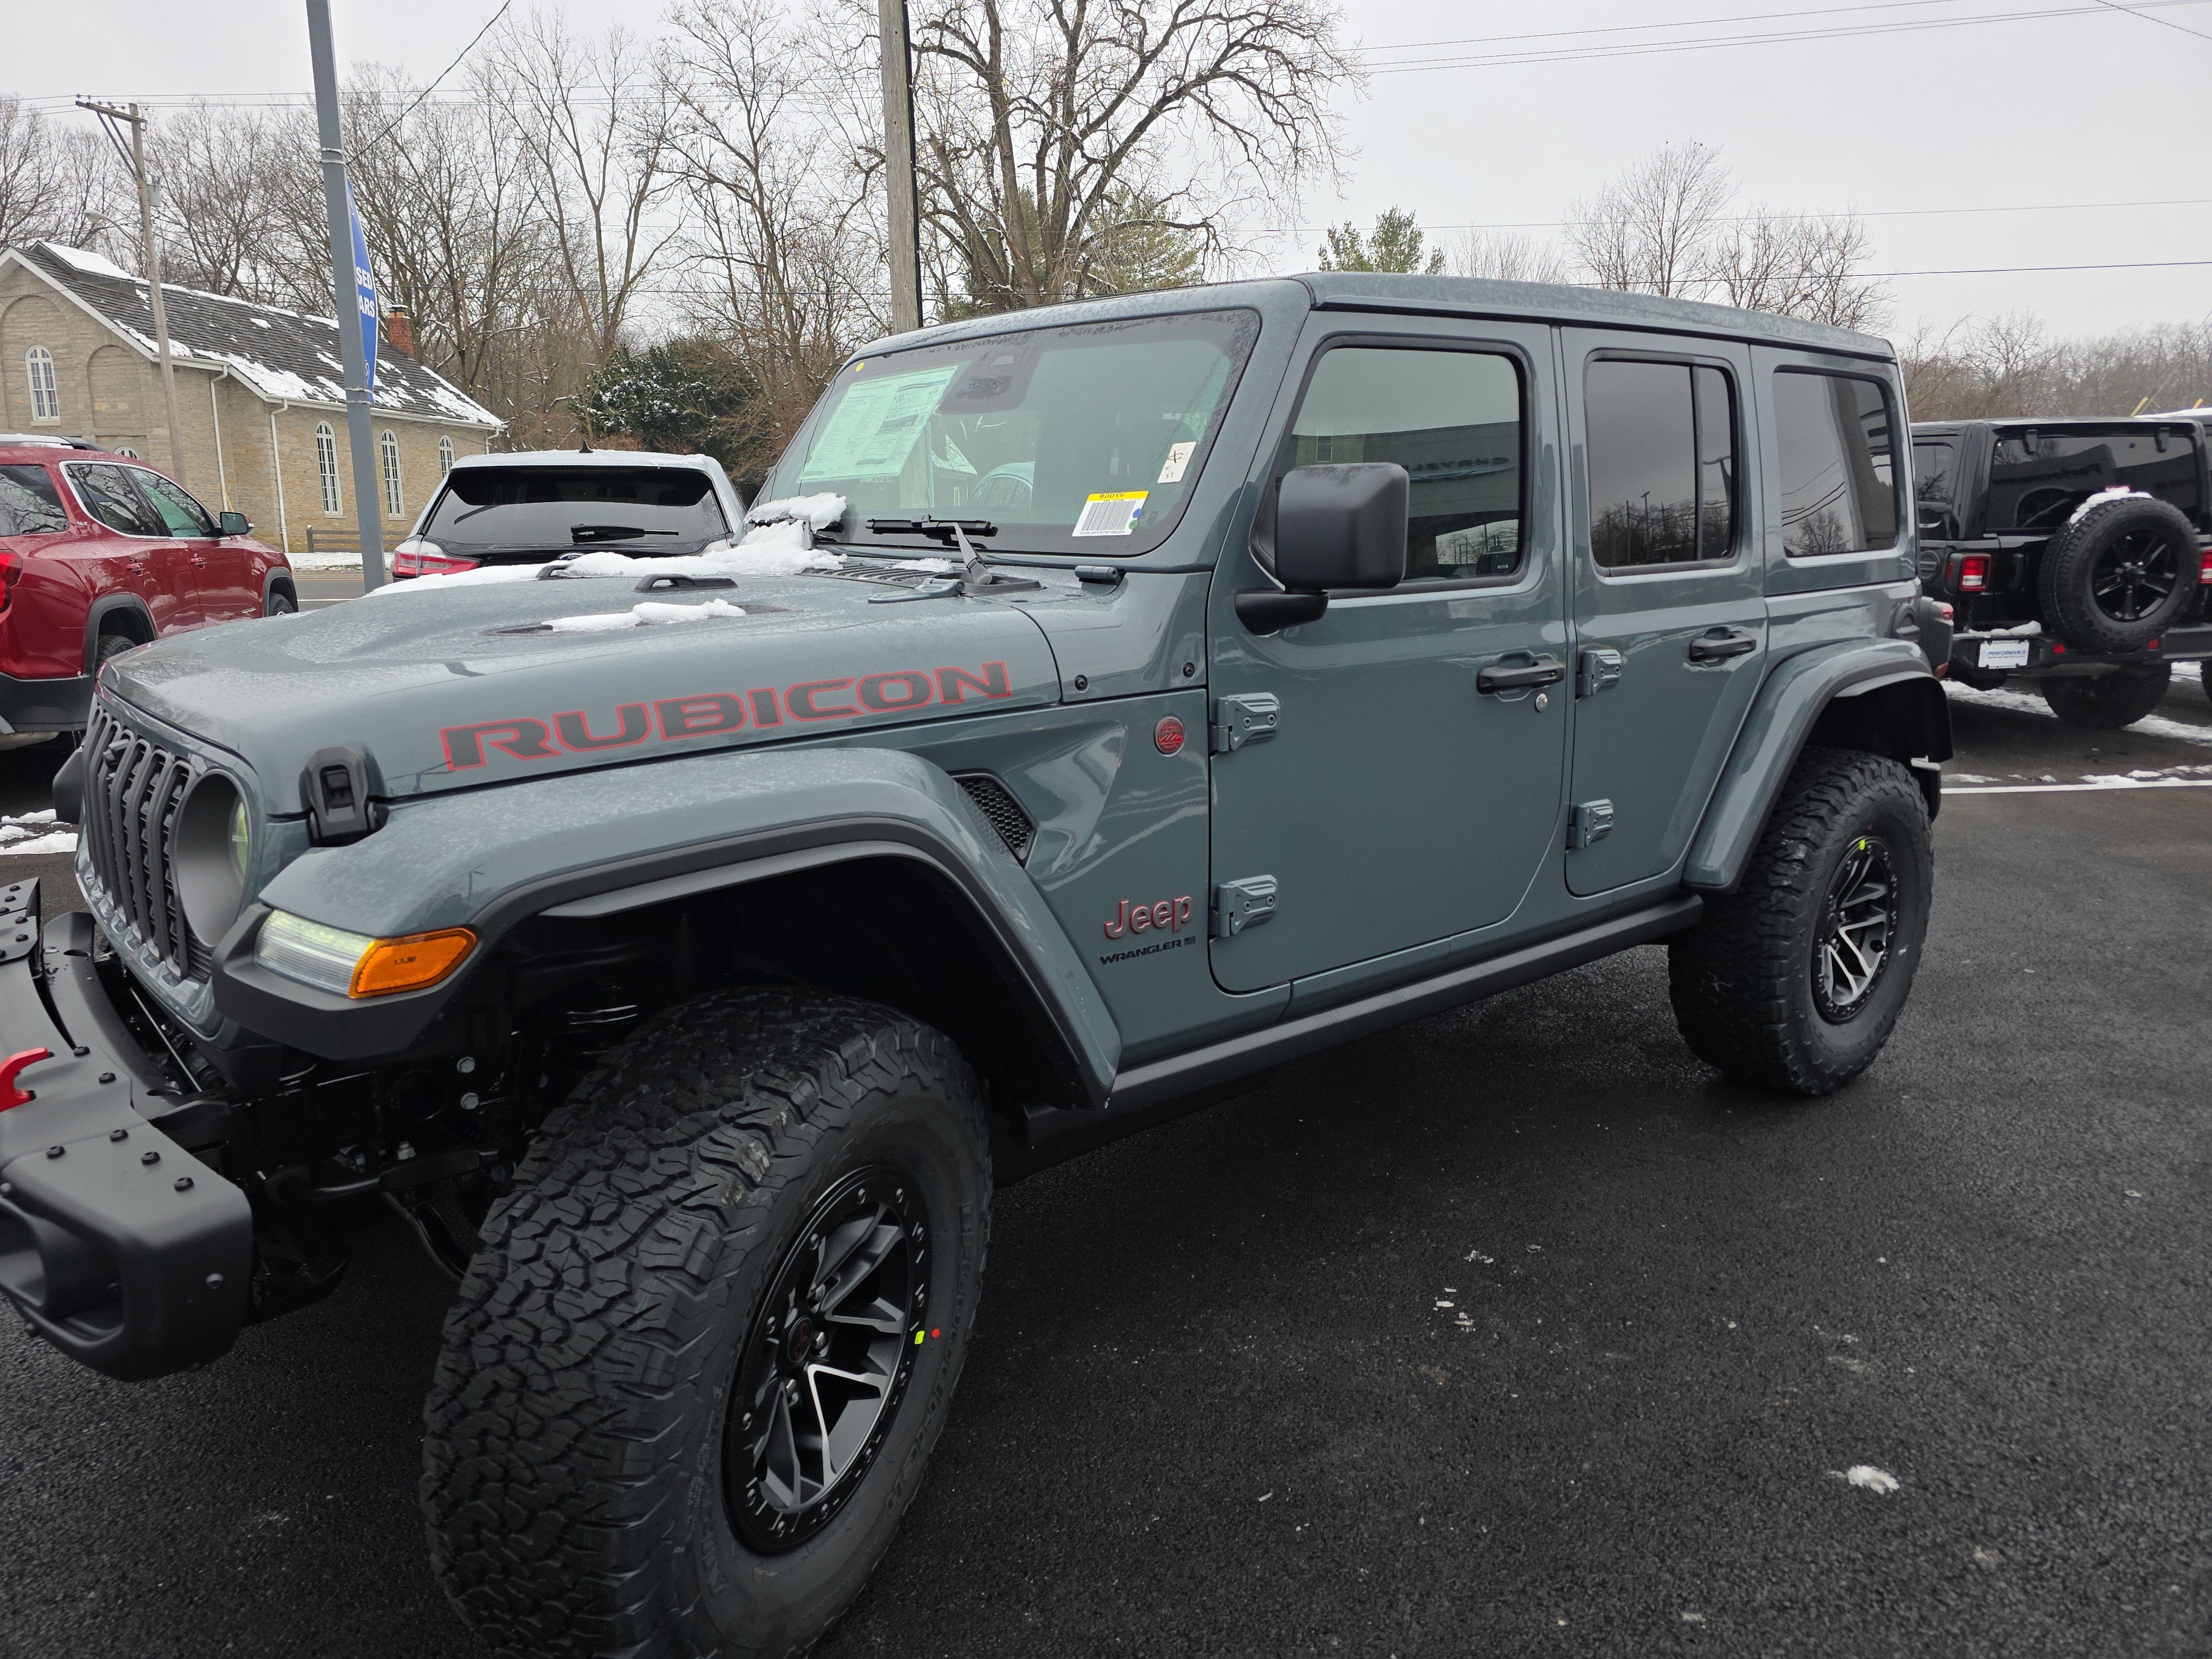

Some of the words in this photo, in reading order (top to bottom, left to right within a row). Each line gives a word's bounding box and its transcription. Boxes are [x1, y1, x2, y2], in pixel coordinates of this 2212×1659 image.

[356, 266, 372, 290] SED
[358, 295, 375, 318] ARS
[440, 661, 1011, 771] RUBICON
[1104, 895, 1194, 940] Jeep
[1099, 939, 1181, 964] WRANGLER
